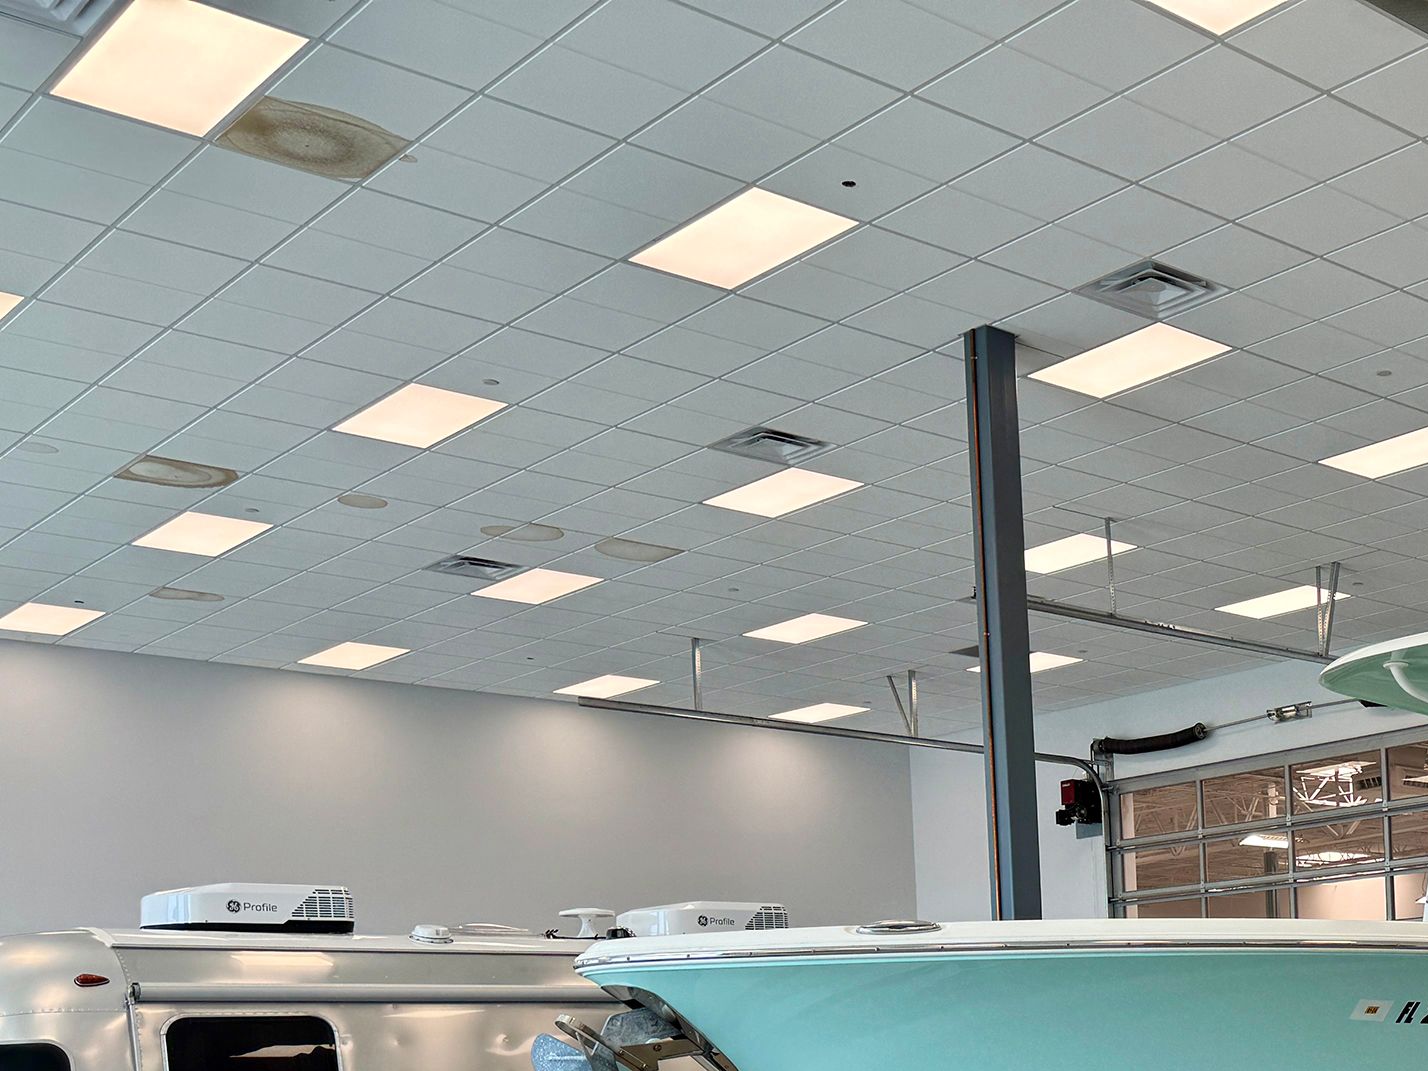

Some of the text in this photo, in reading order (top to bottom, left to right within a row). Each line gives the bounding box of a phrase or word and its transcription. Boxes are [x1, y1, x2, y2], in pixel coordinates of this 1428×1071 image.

[243, 902, 278, 912] Profile
[709, 917, 735, 926] Profile
[1395, 1001, 1422, 1024] FL
